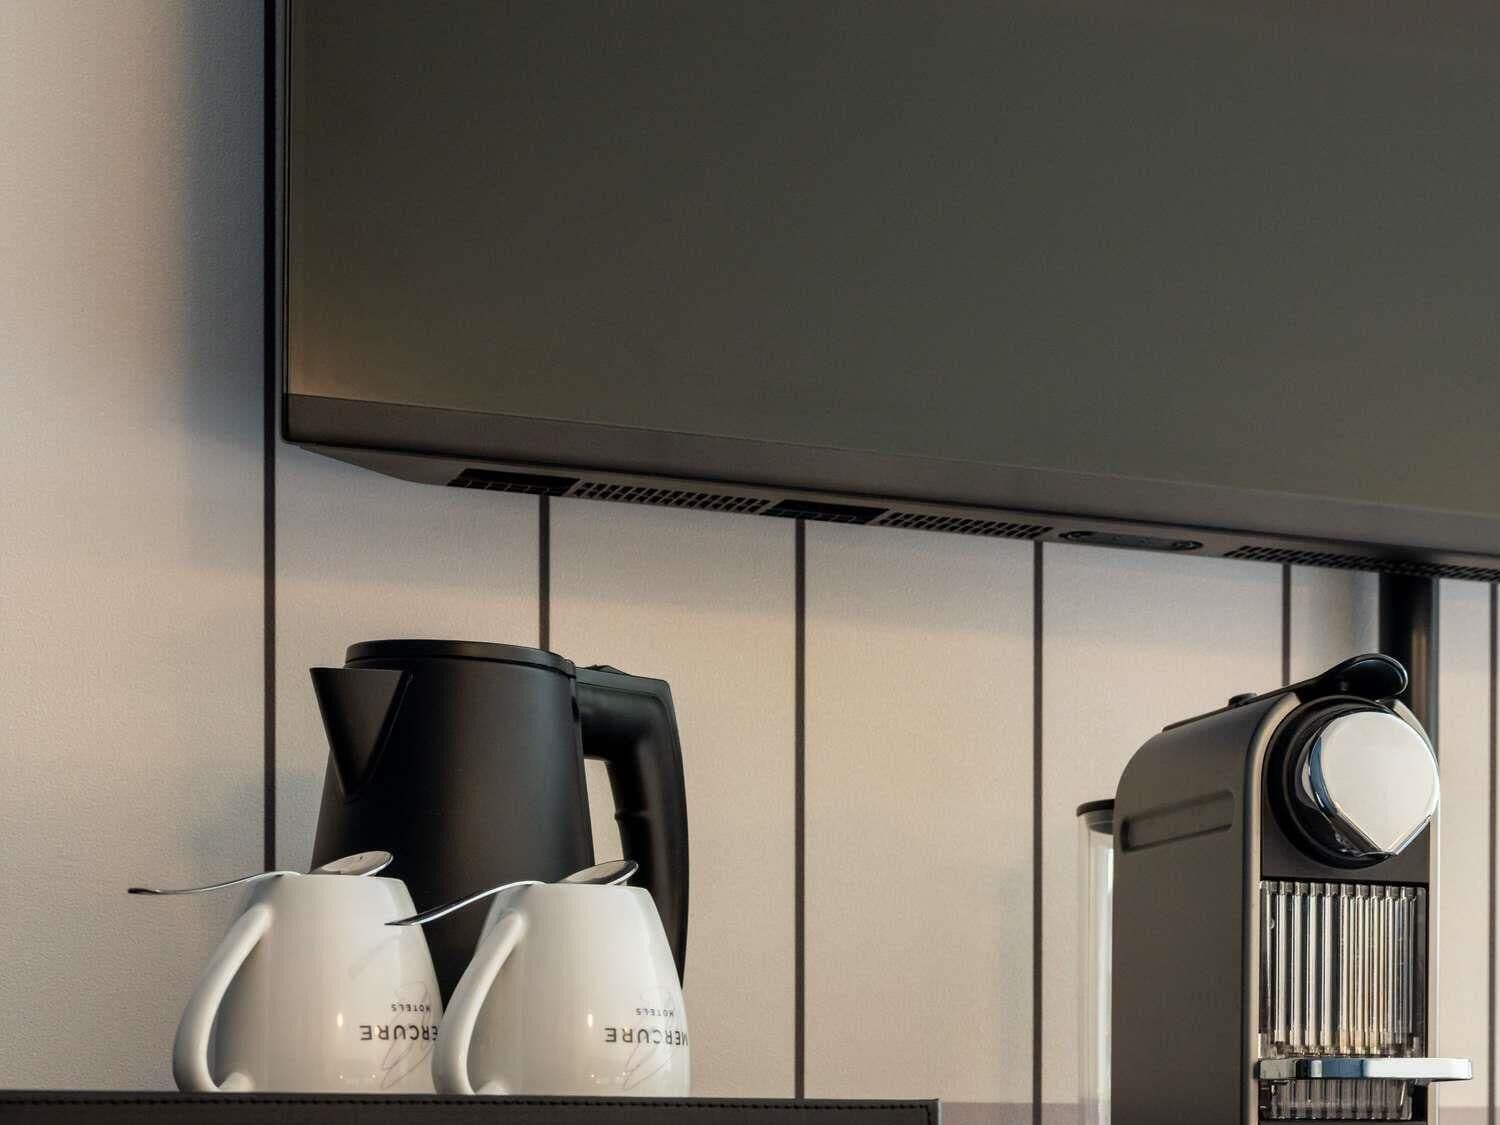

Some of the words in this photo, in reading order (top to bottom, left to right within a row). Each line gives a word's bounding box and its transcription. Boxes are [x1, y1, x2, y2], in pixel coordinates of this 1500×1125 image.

[391, 1003, 431, 1012] HOTELS
[635, 1008, 674, 1017] HOTELS
[360, 1025, 438, 1040] ERCURE
[604, 1027, 688, 1046] MERCURE
